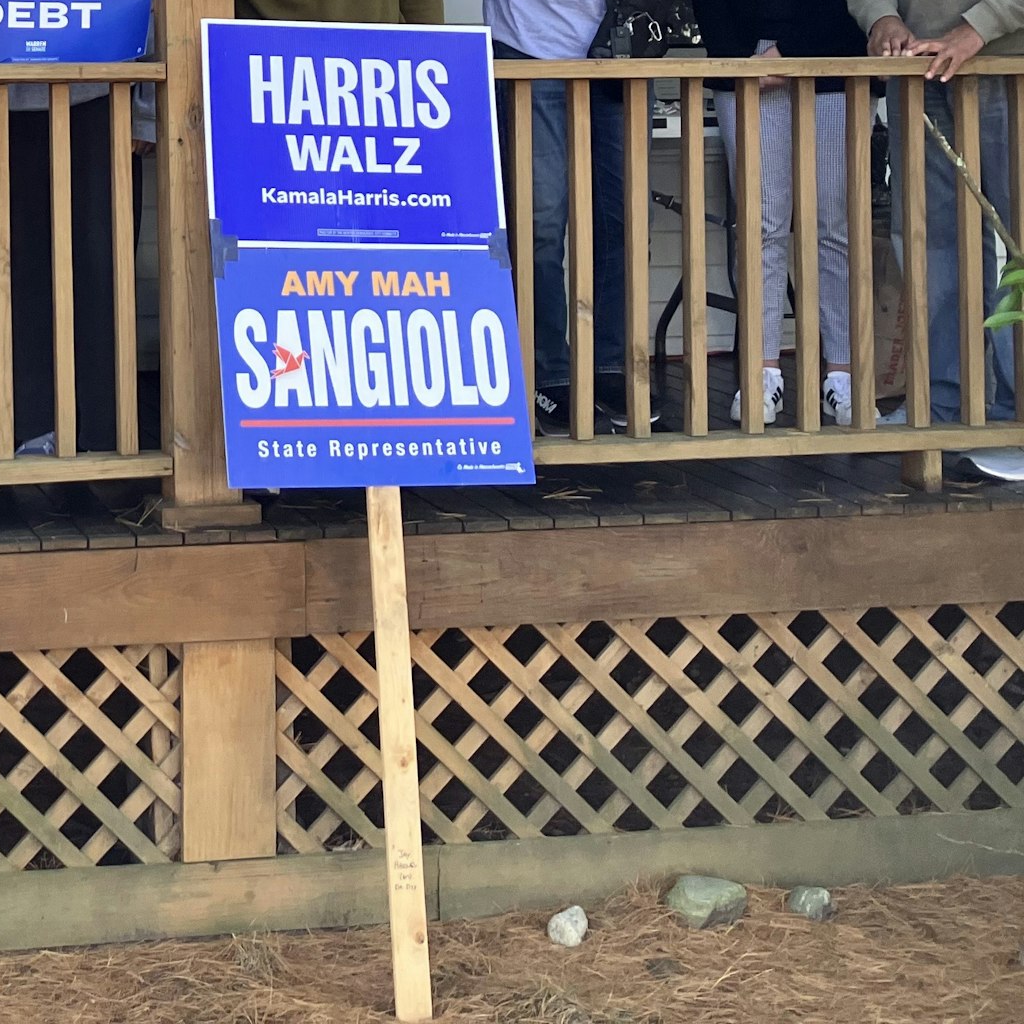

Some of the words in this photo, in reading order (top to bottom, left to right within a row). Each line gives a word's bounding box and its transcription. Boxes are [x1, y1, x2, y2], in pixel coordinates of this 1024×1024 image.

[248, 54, 452, 130] HARRIS
[285, 134, 423, 175] WALZ
[261, 187, 452, 208] KamalaHarris.com
[281, 270, 360, 297] AMY
[371, 270, 451, 297] MAH
[233, 307, 511, 409] SANGIOLO
[257, 438, 318, 459] State
[329, 439, 503, 462] Representative
